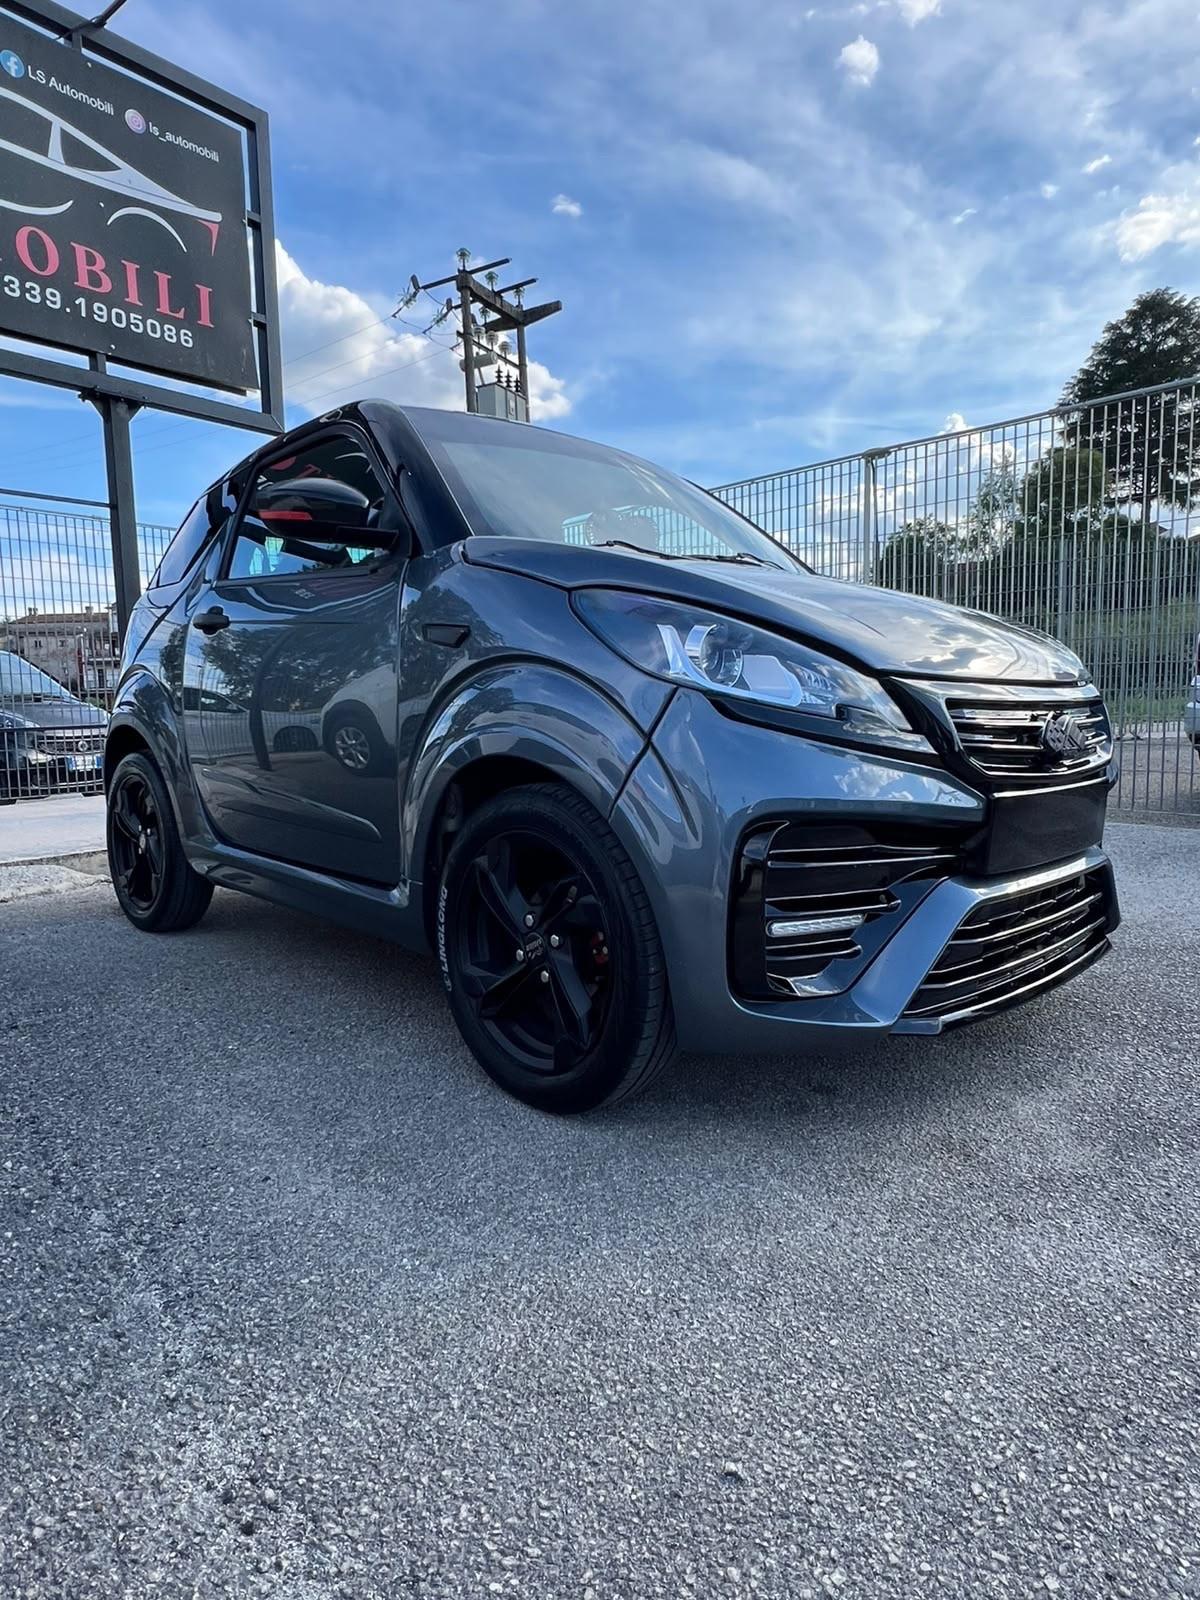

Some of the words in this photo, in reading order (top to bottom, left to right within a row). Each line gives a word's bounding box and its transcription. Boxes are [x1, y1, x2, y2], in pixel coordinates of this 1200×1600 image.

[28, 65, 46, 84] LS
[49, 77, 114, 115] Automobili
[3, 275, 194, 348] 339.1905086
